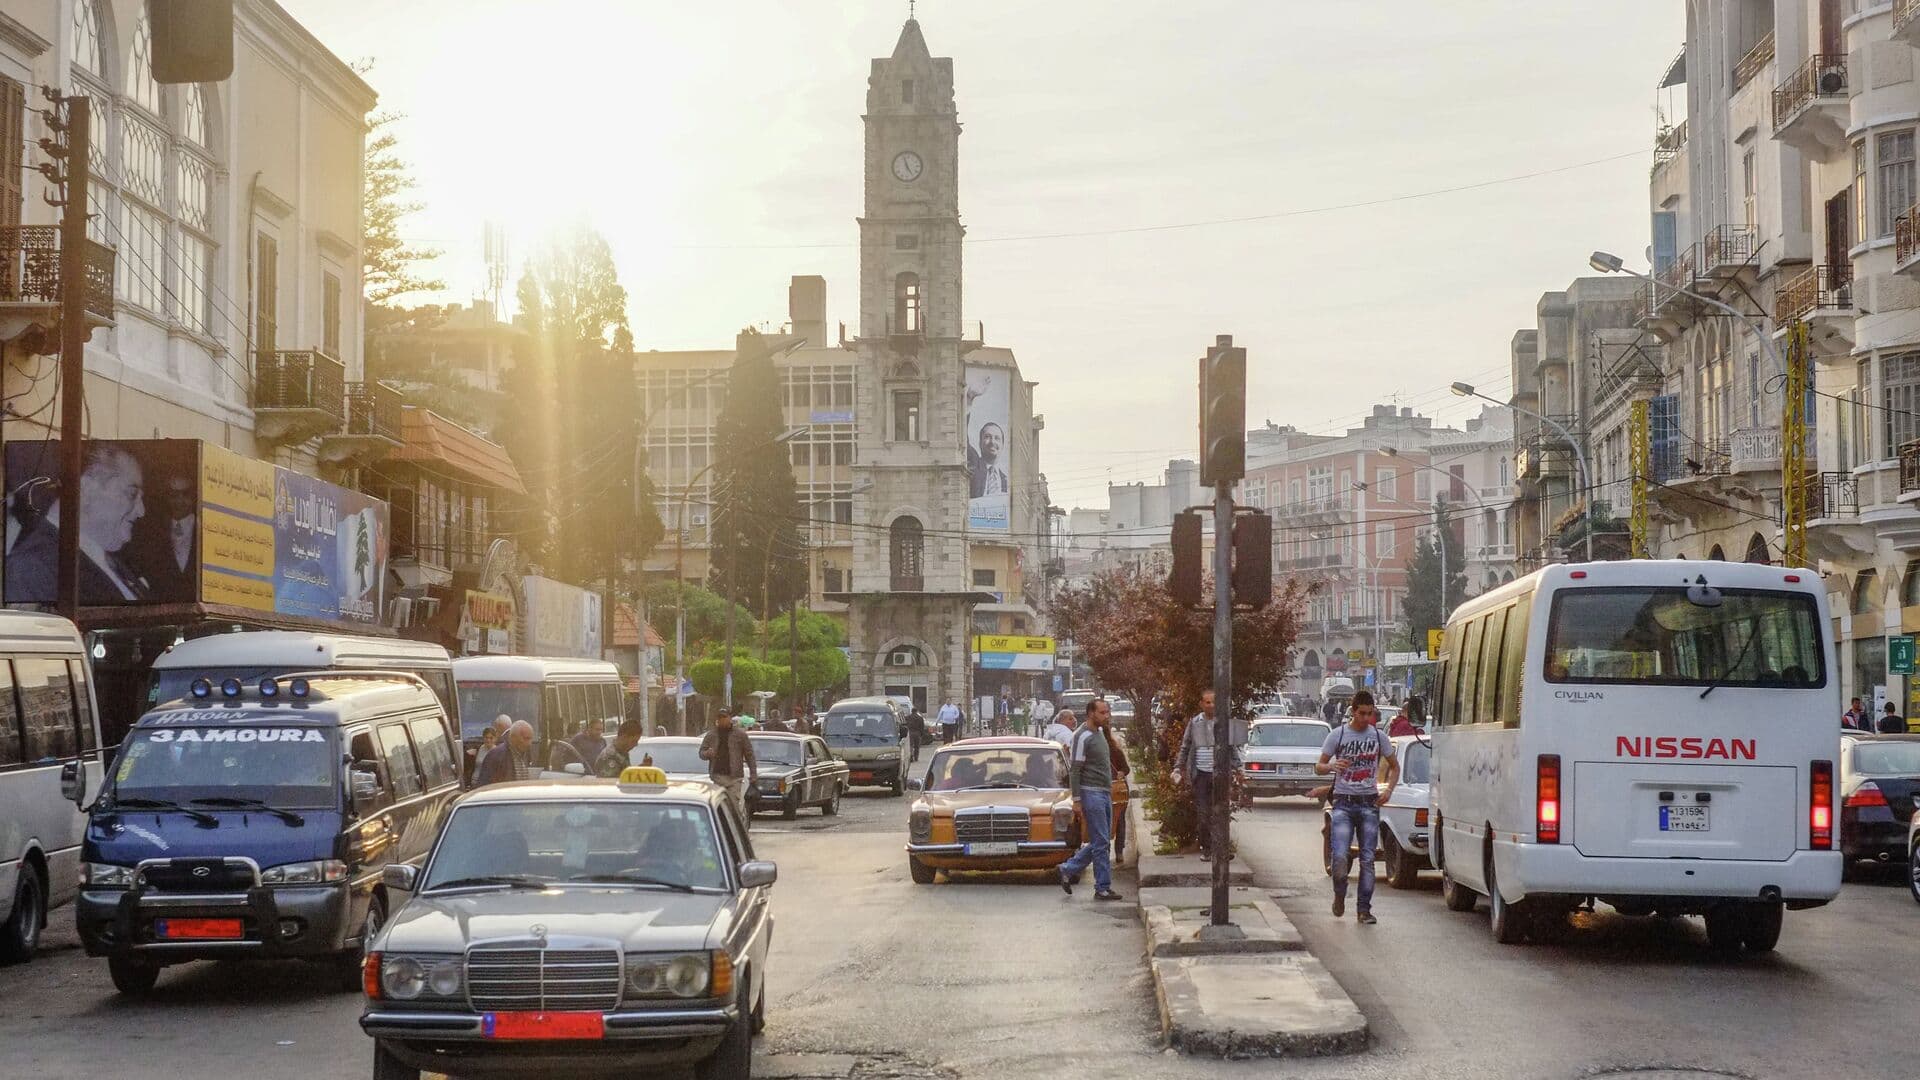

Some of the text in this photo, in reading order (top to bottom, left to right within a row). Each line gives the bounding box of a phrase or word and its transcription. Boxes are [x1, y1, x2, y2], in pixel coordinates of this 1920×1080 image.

[991, 639, 1009, 647] OMT
[1554, 690, 1604, 699] CIVILIAN
[155, 711, 248, 724] HASOUN
[150, 729, 325, 742] 3AMOURA
[1339, 740, 1376, 755] MAKIN
[1616, 736, 1756, 760] NISSAN
[626, 772, 658, 782] TAXI
